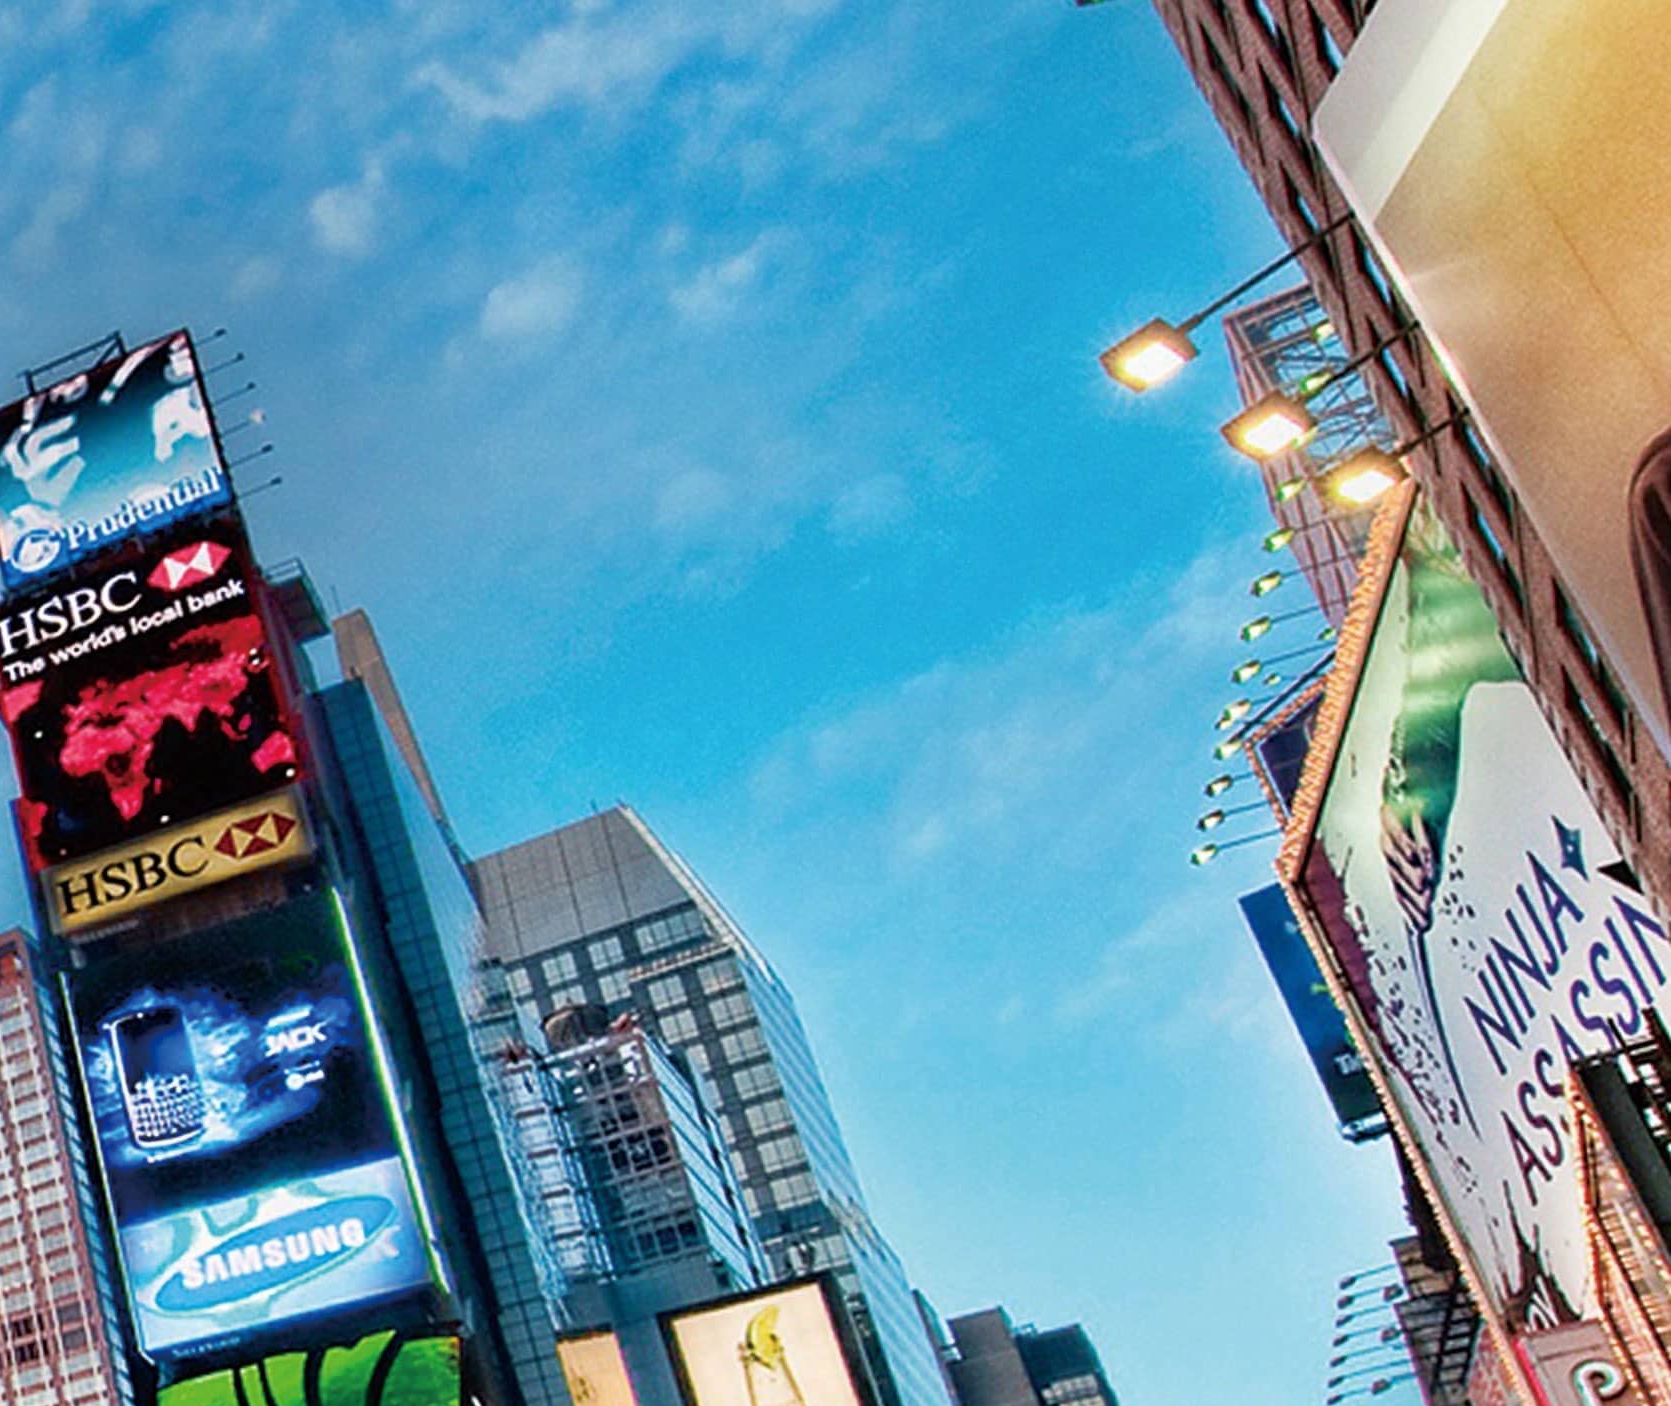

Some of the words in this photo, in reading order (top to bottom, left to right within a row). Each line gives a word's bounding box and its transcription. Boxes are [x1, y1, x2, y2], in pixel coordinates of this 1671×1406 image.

[66, 468, 220, 550] Prudential
[3, 653, 45, 682] The
[50, 624, 128, 666] world's
[130, 601, 184, 636] local
[186, 579, 245, 614] bank
[57, 836, 210, 916] HSBC
[1464, 851, 1584, 1075] NINJA
[179, 1218, 366, 1291] SAMSUNG
